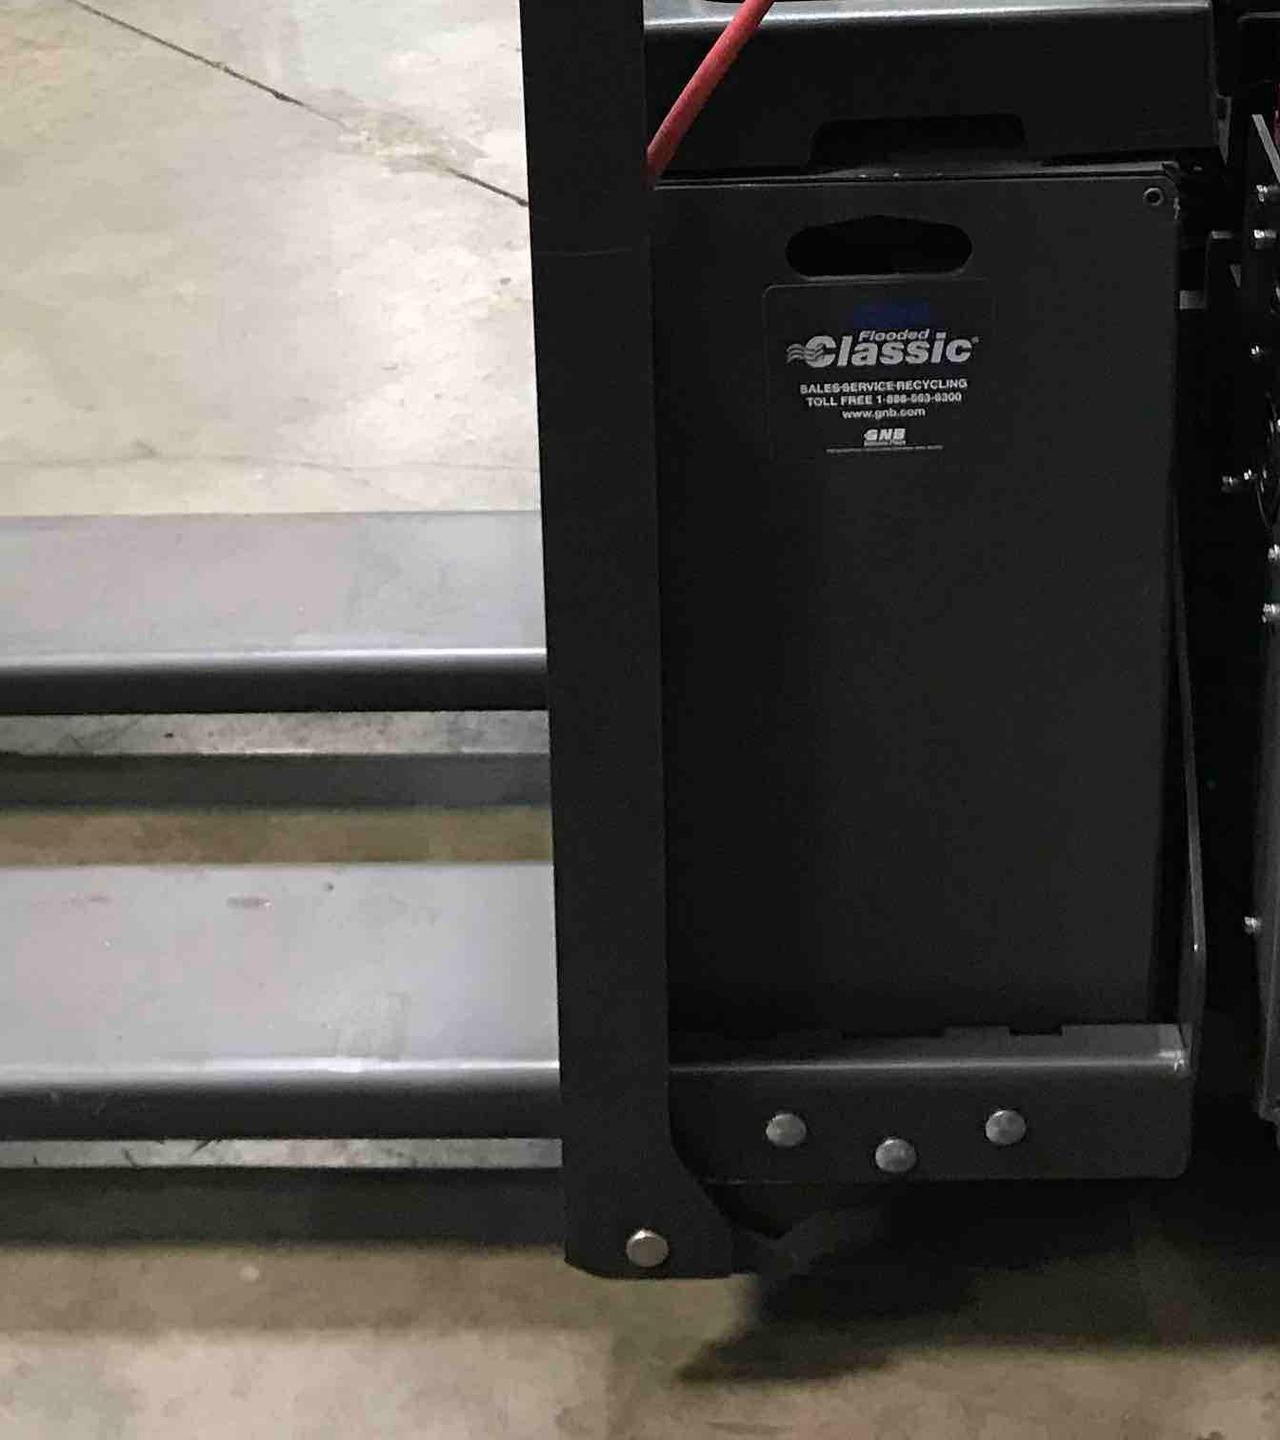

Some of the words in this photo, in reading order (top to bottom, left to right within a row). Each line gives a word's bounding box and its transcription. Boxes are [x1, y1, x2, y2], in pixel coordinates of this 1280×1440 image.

[857, 328, 930, 342] Flooded
[806, 396, 838, 408] TOLL
[840, 394, 873, 406] FREE
[841, 407, 926, 420] www.gnb.com
